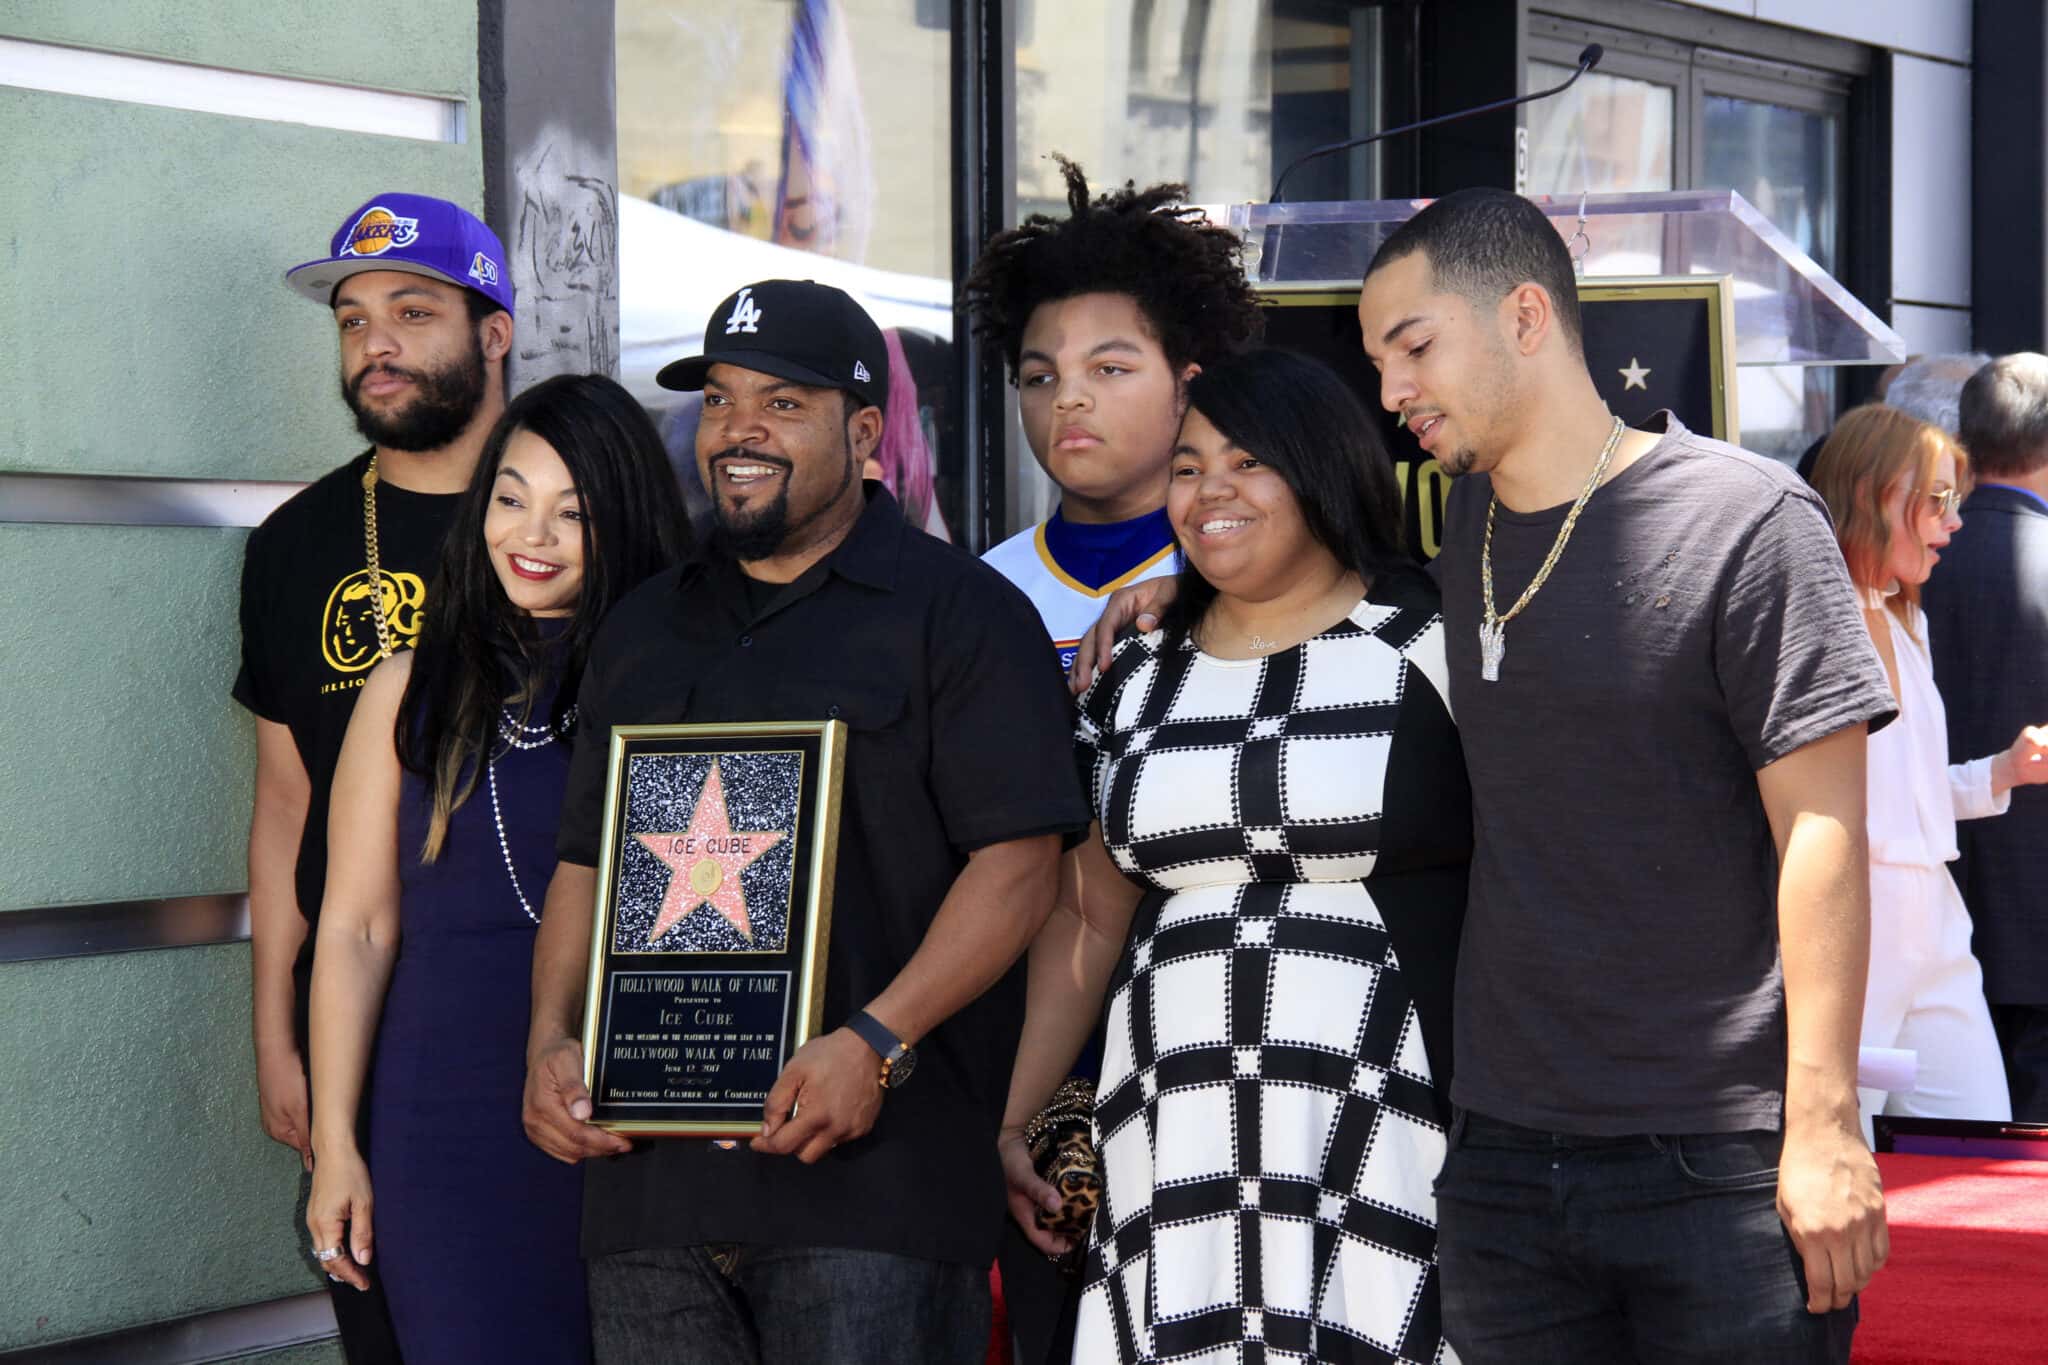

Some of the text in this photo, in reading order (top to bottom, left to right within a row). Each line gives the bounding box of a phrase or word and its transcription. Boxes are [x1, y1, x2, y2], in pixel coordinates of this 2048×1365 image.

[342, 222, 418, 252] LAKERS
[483, 261, 495, 281] 50
[725, 288, 762, 335] LA
[668, 837, 752, 855] ICE CUBE
[620, 977, 779, 993] HOLLYWOOD WALK OF FAME
[613, 1047, 773, 1060] HOLLYWOOD WALK OF FAME
[702, 1064, 721, 1073] 2017
